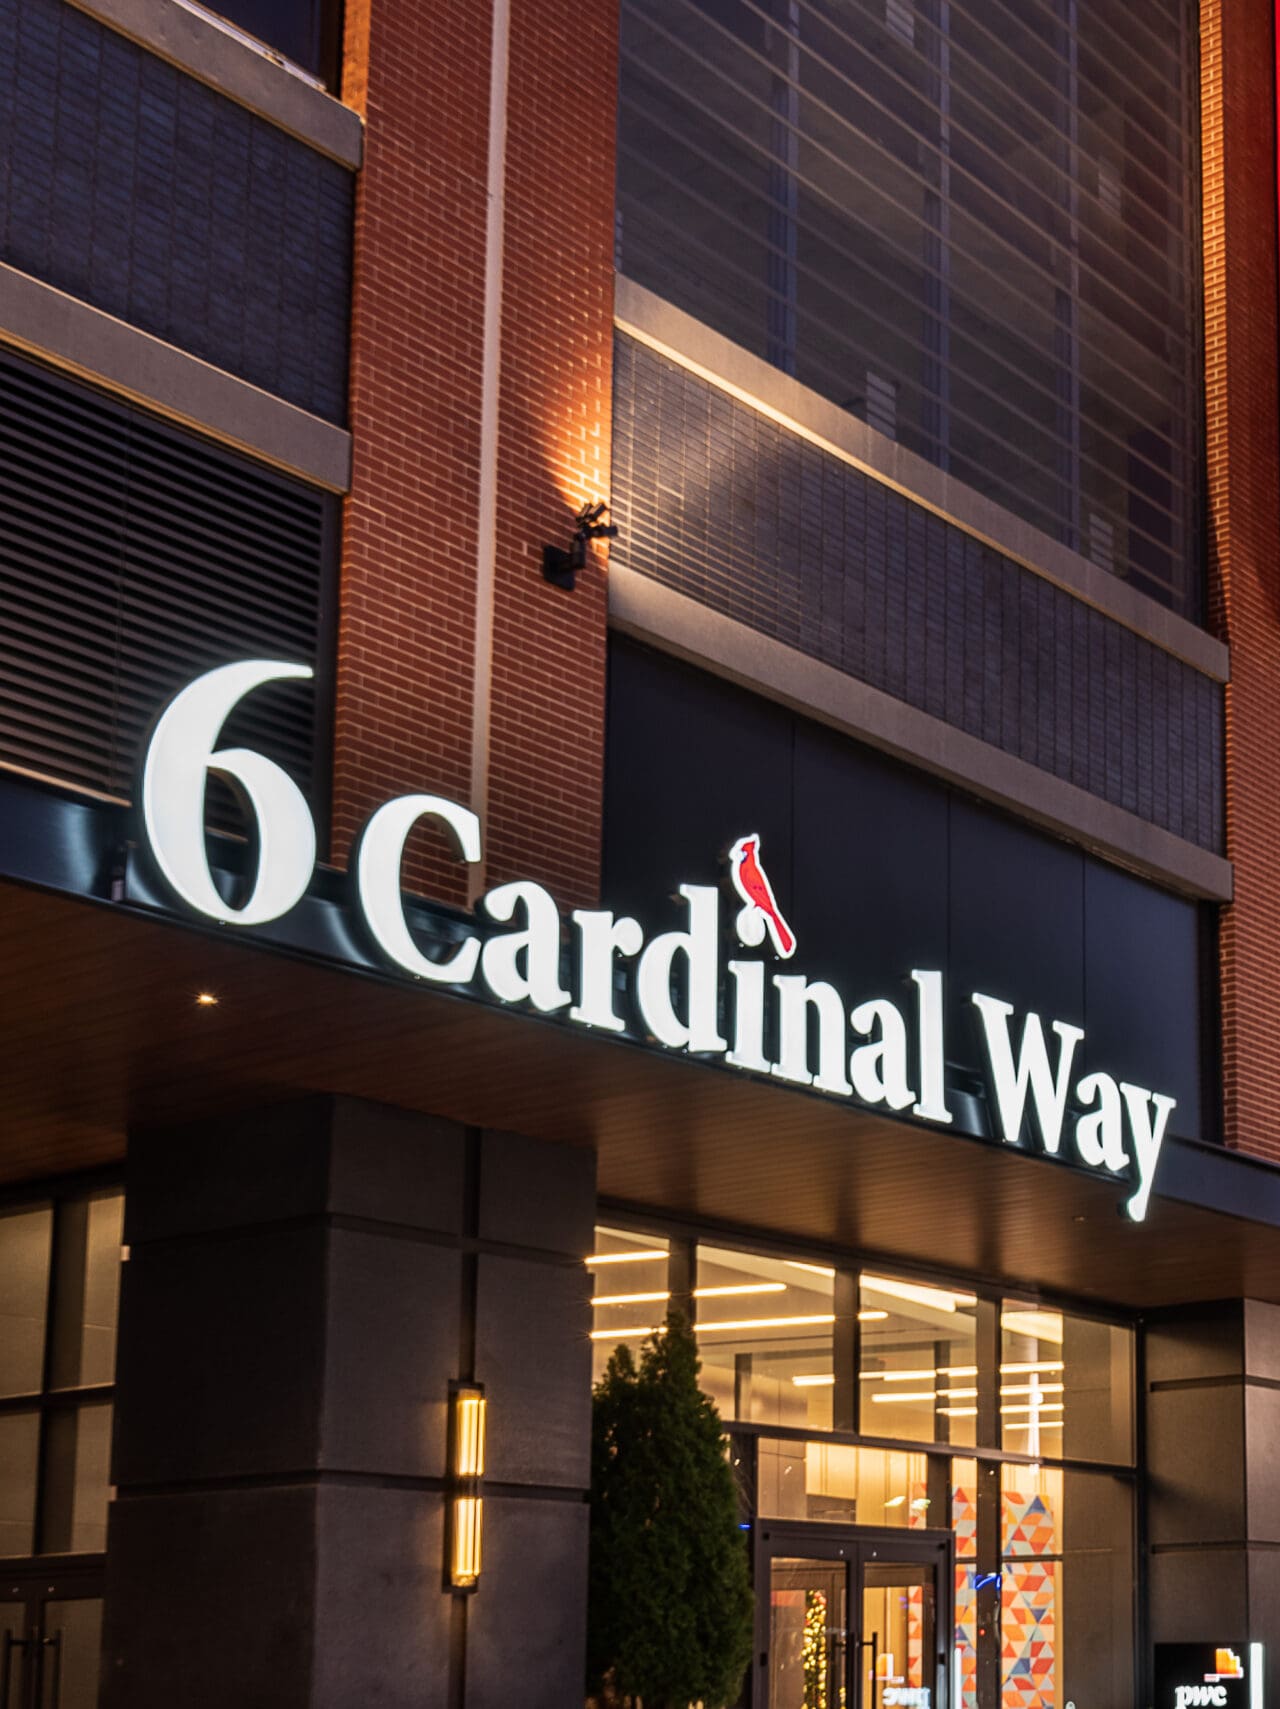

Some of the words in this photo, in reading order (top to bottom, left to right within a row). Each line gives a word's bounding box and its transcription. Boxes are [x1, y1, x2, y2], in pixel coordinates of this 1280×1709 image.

[143, 659, 316, 926] 6
[358, 794, 953, 1124] Cardinal
[972, 992, 1176, 1223] Way
[1174, 1685, 1228, 1709] pwc
